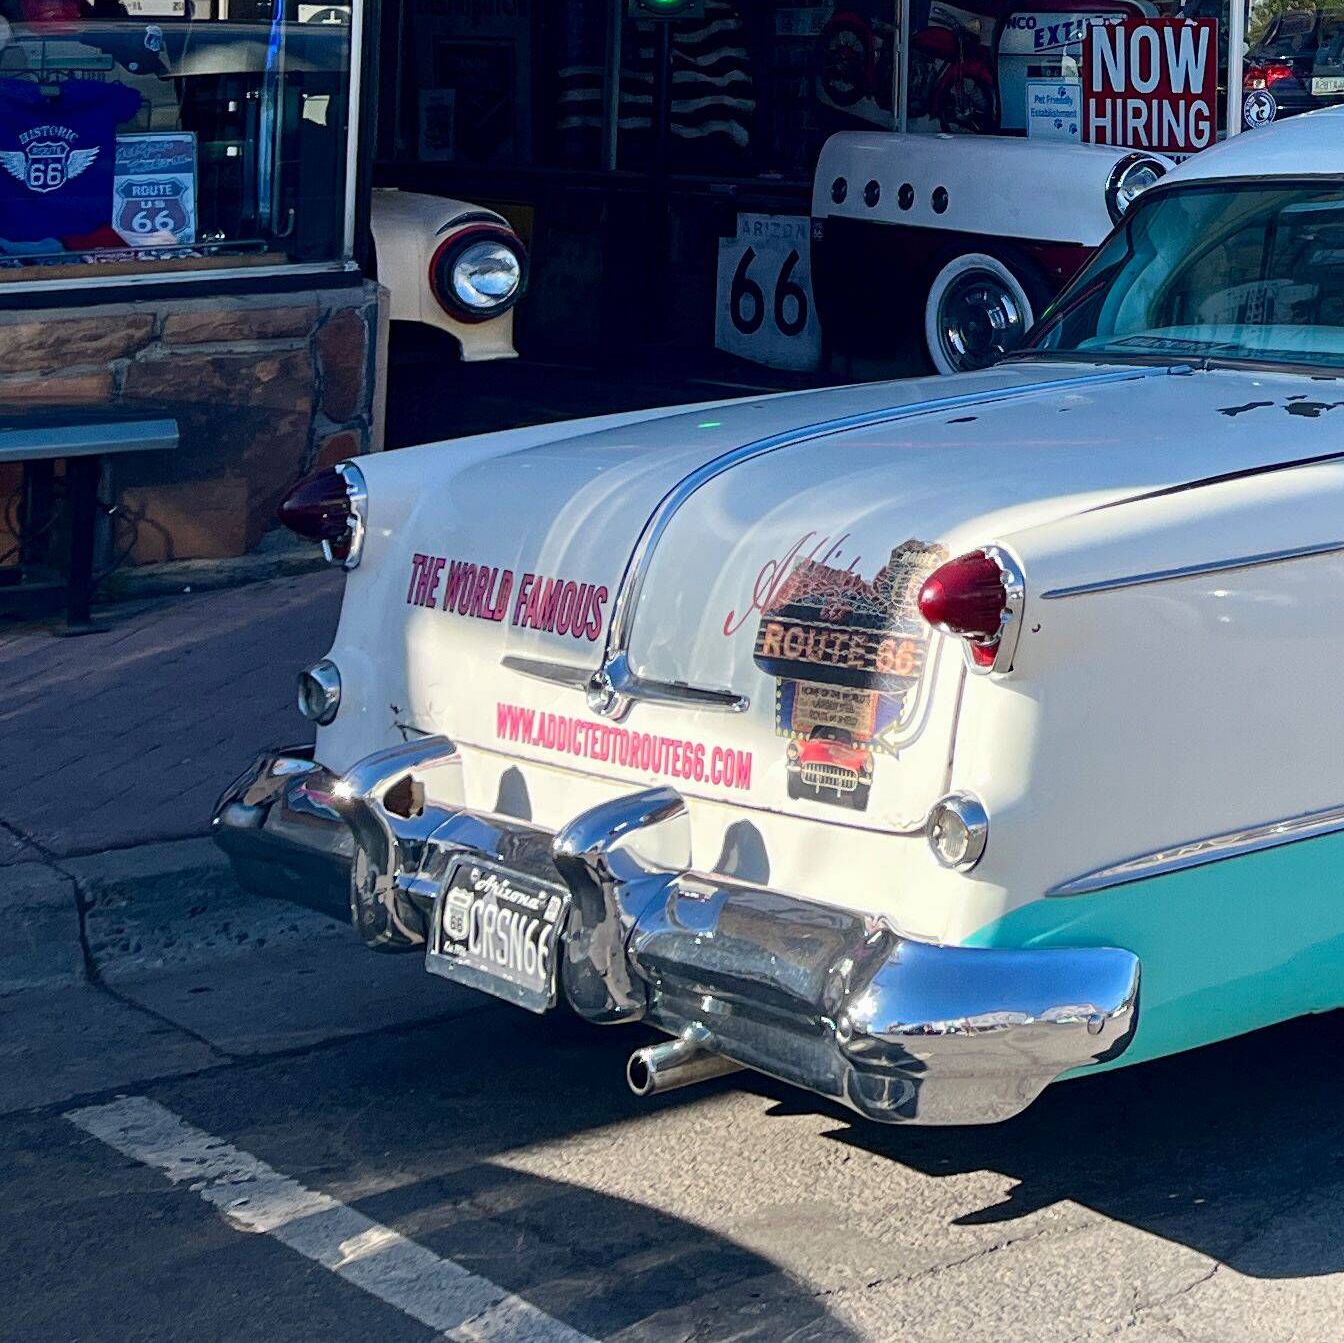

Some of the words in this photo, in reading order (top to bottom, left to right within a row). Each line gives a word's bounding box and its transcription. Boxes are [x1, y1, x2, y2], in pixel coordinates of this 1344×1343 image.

[1091, 25, 1210, 95] NOW
[1034, 95, 1046, 104] Pet
[18, 125, 79, 144] HISTORIC
[1089, 98, 1211, 149] HIRING
[29, 163, 62, 186] 66
[132, 184, 173, 196] ROUTE
[131, 210, 175, 233] 66
[729, 245, 809, 337] 66
[406, 553, 447, 609] THE
[442, 559, 515, 622] WORLD
[512, 572, 609, 643] FAMOUS
[762, 622, 867, 670] ROUTE
[875, 638, 918, 676] 66
[496, 701, 753, 791] WWW.ADDICTEDTOROUTE66.COM
[474, 874, 541, 910] Arizona
